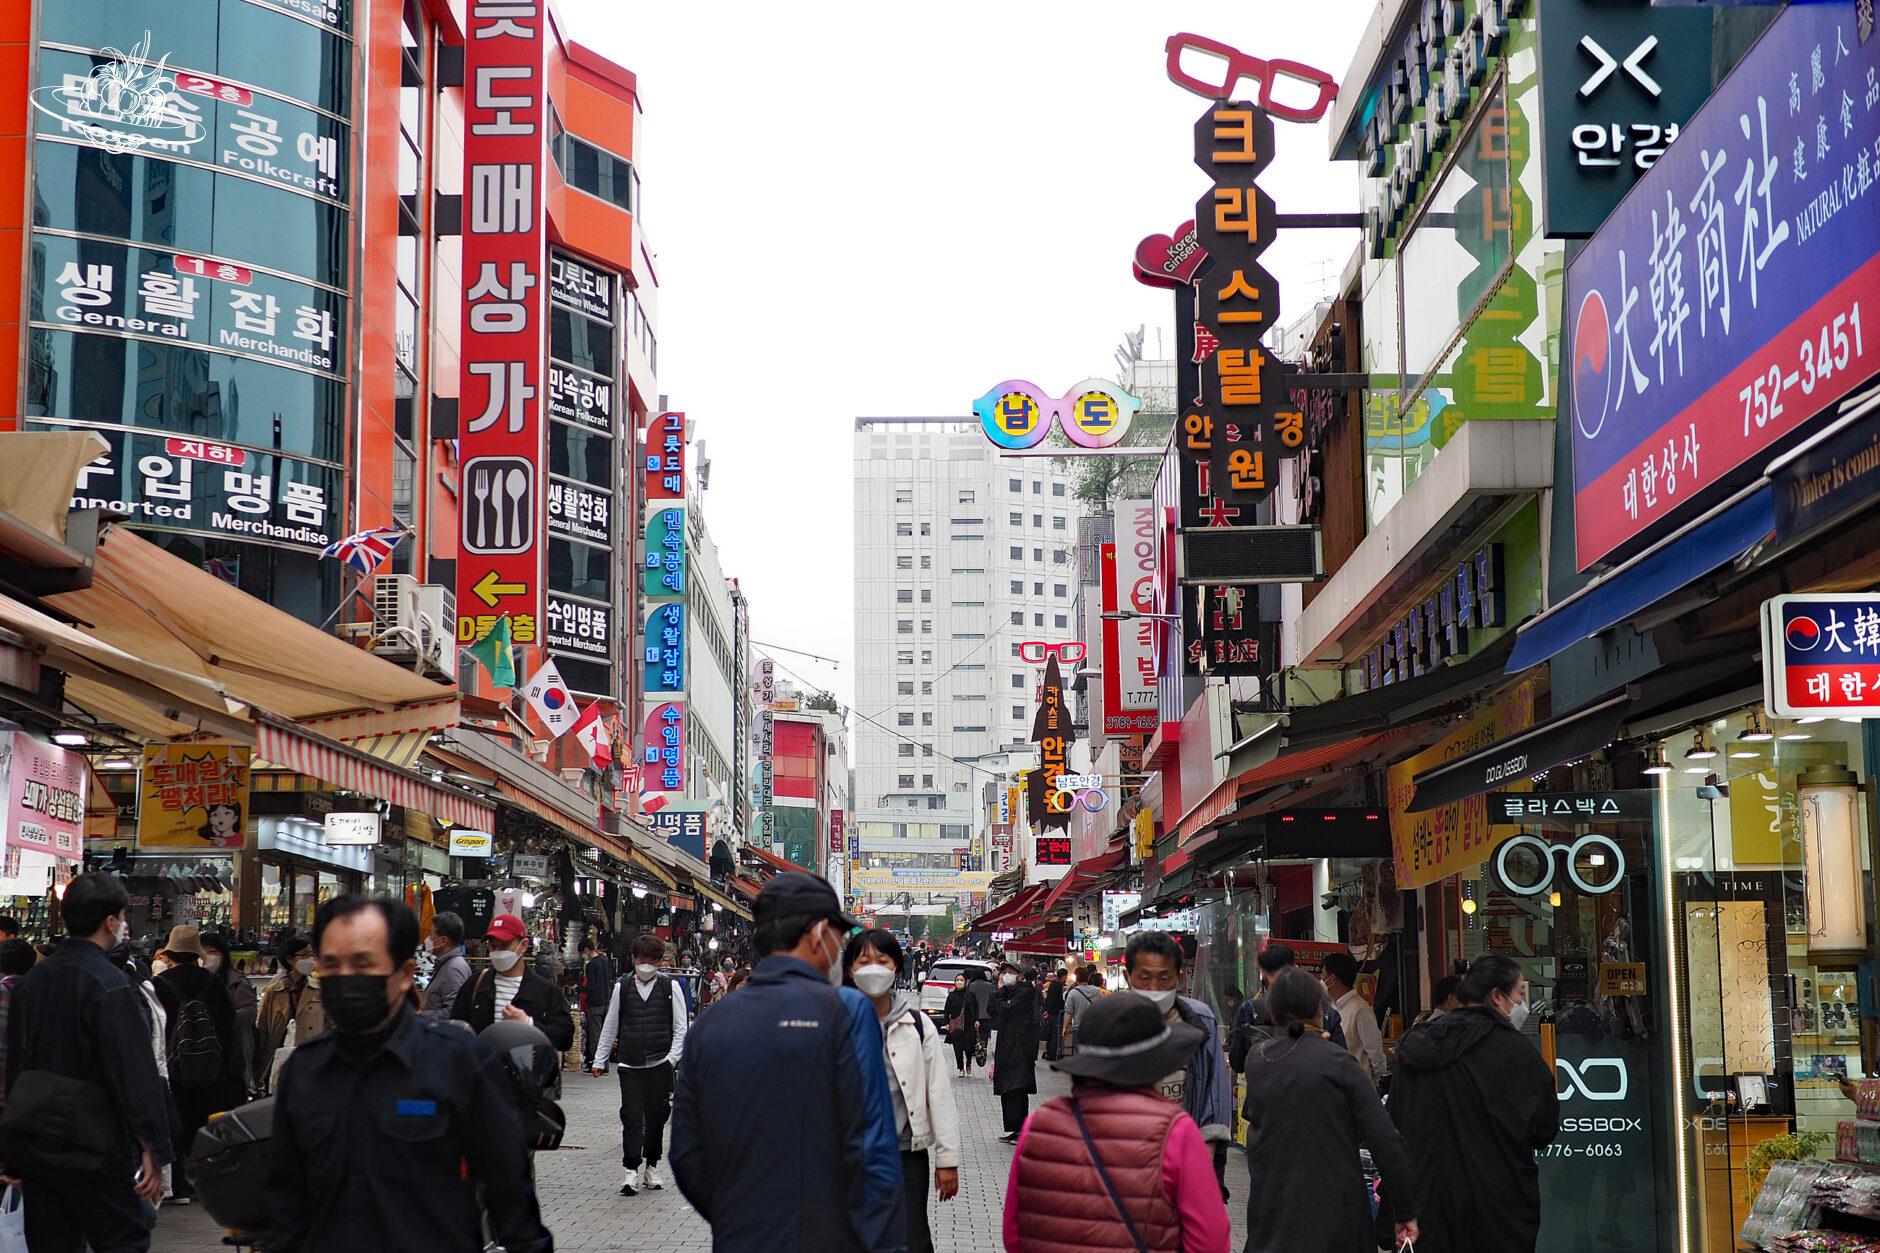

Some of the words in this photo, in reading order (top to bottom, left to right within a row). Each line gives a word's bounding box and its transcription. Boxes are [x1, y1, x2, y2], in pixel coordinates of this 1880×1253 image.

[187, 77, 242, 102] 2층
[223, 150, 338, 197] Folkcraft
[1796, 180, 1842, 246] NATURAL
[188, 259, 240, 281] 1층
[1163, 241, 1200, 272] Ginsen
[1212, 110, 1265, 405] 크리스탈
[55, 261, 334, 351] 생활잡화
[55, 305, 188, 338] General
[219, 329, 332, 368] Merchandise
[1738, 301, 1863, 437] 752-3451
[549, 368, 609, 415] 민속공예
[576, 408, 608, 428] Folkcraft
[179, 441, 235, 463] 지하
[663, 415, 682, 494] 그릇도매
[1622, 422, 1700, 520] 대한상사
[548, 484, 608, 527] 생활잡화
[211, 511, 329, 545] Merchandise
[548, 514, 570, 533] General
[571, 520, 608, 541] Merchandise
[662, 510, 682, 592] 민속공예
[548, 600, 607, 640] 수입명품
[573, 638, 607, 654] Merchandise
[662, 605, 681, 688] 생활잡화
[1806, 671, 1880, 703] 대한
[1046, 686, 1059, 730] 카이스트
[662, 705, 681, 789] 수입명품
[1057, 776, 1101, 788] 남도안경
[1503, 798, 1621, 816] 글라스박스
[455, 837, 486, 846] Grisport
[1722, 881, 1764, 891] TIME
[1607, 968, 1636, 980] OPEN
[1559, 1118, 1642, 1132] SSBOX
